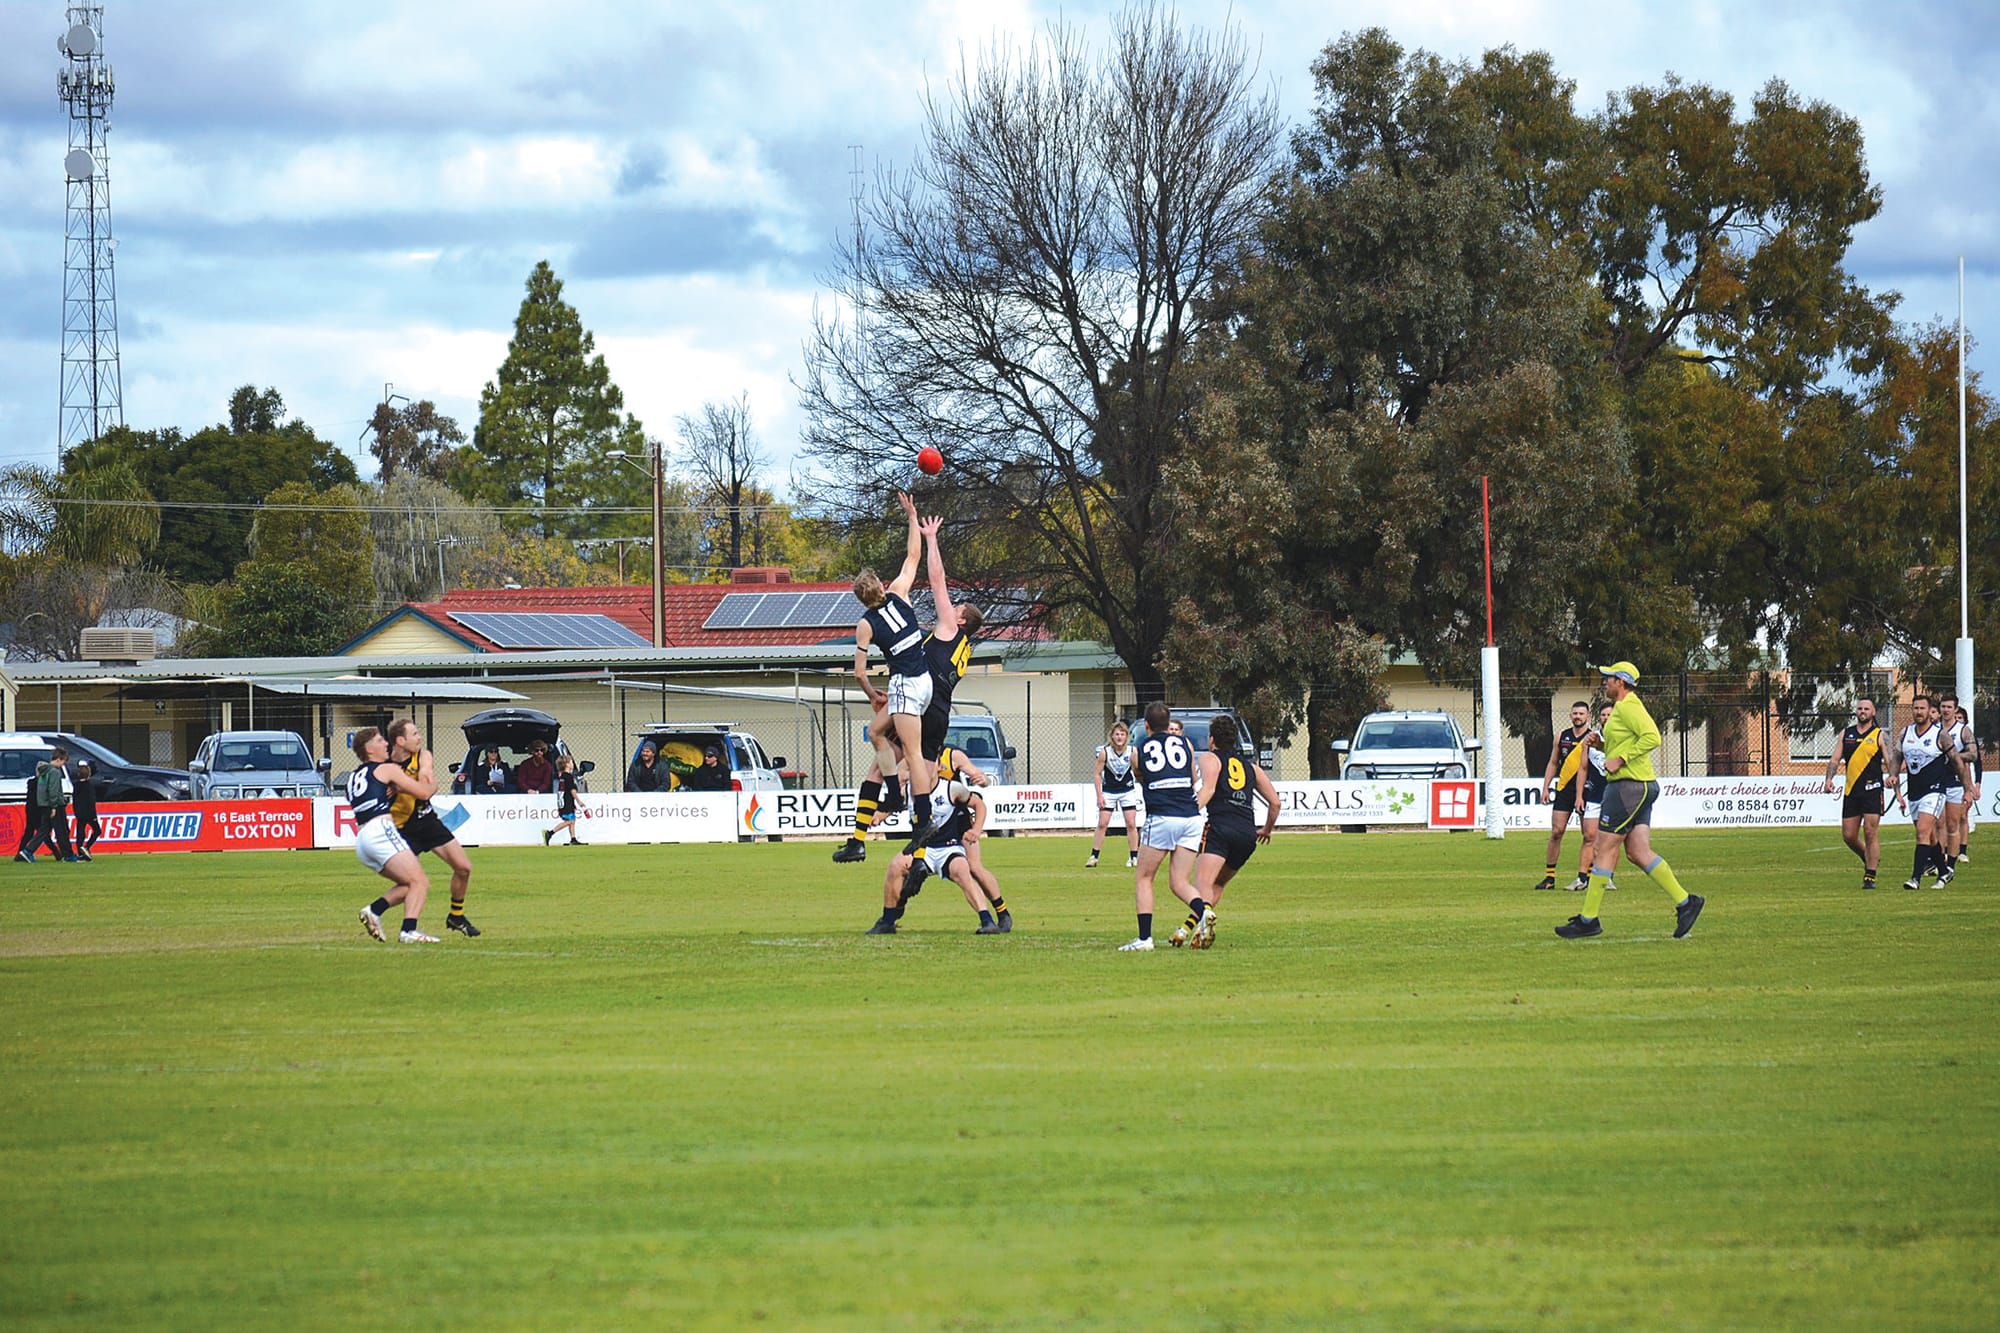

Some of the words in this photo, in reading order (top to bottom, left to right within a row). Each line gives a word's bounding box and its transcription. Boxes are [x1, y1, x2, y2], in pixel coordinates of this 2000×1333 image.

[878, 600, 908, 634] 11
[1143, 736, 1187, 772] 36
[1227, 757, 1246, 790] 9
[347, 766, 369, 801] 18
[1664, 784, 1687, 796] The
[1690, 784, 1727, 796] smart
[1732, 782, 1770, 796] choice
[1772, 782, 1787, 795] in
[1017, 790, 1053, 800] PHONE
[640, 803, 709, 818] services
[995, 803, 1025, 814] 0422
[1029, 802, 1049, 813] 752
[1054, 802, 1075, 812] 474
[1718, 801, 1733, 811] 08
[1738, 800, 1769, 810] 8584
[1773, 800, 1805, 810] 6797
[213, 812, 226, 823] 16
[230, 812, 256, 822] East
[258, 811, 303, 821] Terrace
[778, 811, 899, 827] PLUMBG
[1478, 816, 1531, 826] HMES
[1695, 814, 1812, 824] www.handbuilt.com.au
[224, 823, 296, 838] LOXTON
